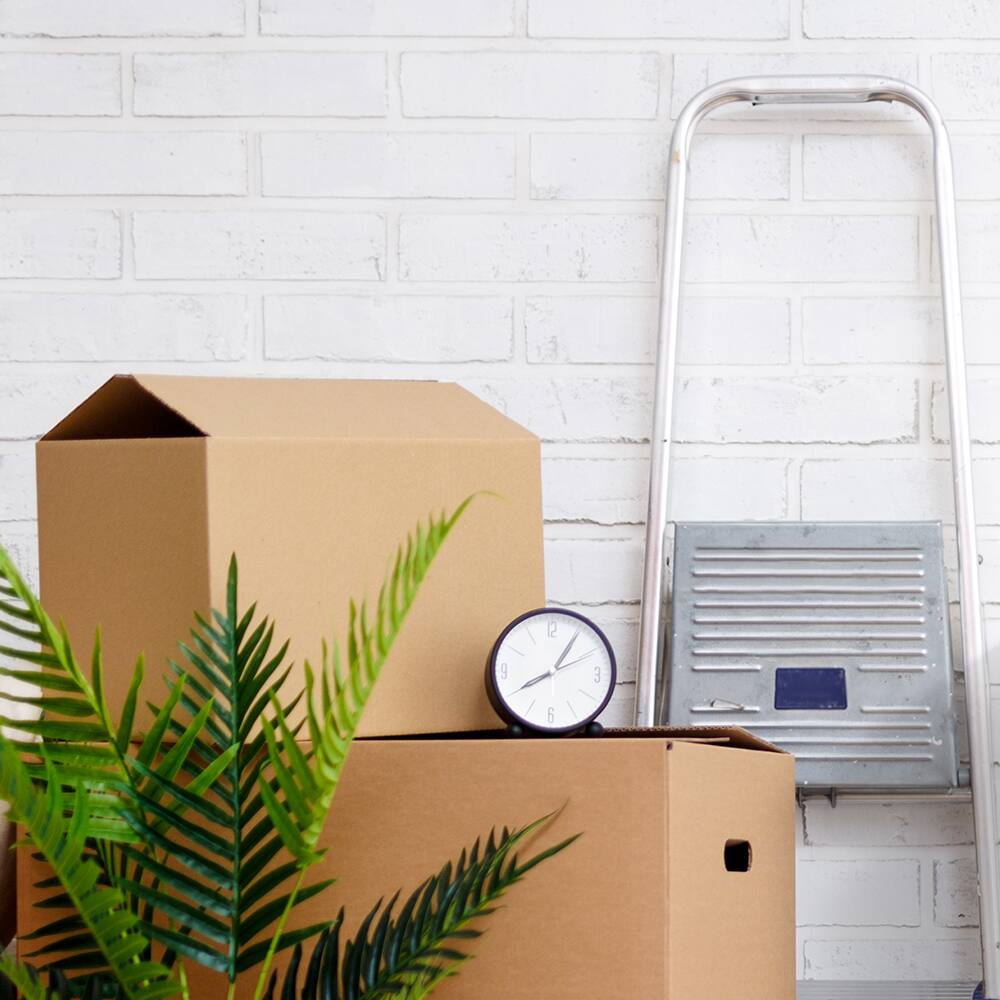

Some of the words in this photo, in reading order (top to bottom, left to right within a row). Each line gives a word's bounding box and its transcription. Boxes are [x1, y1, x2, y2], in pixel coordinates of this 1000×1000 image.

[547, 620, 557, 639] 12
[500, 662, 508, 680] 9
[593, 666, 601, 683] 3
[547, 706, 555, 724] 6
